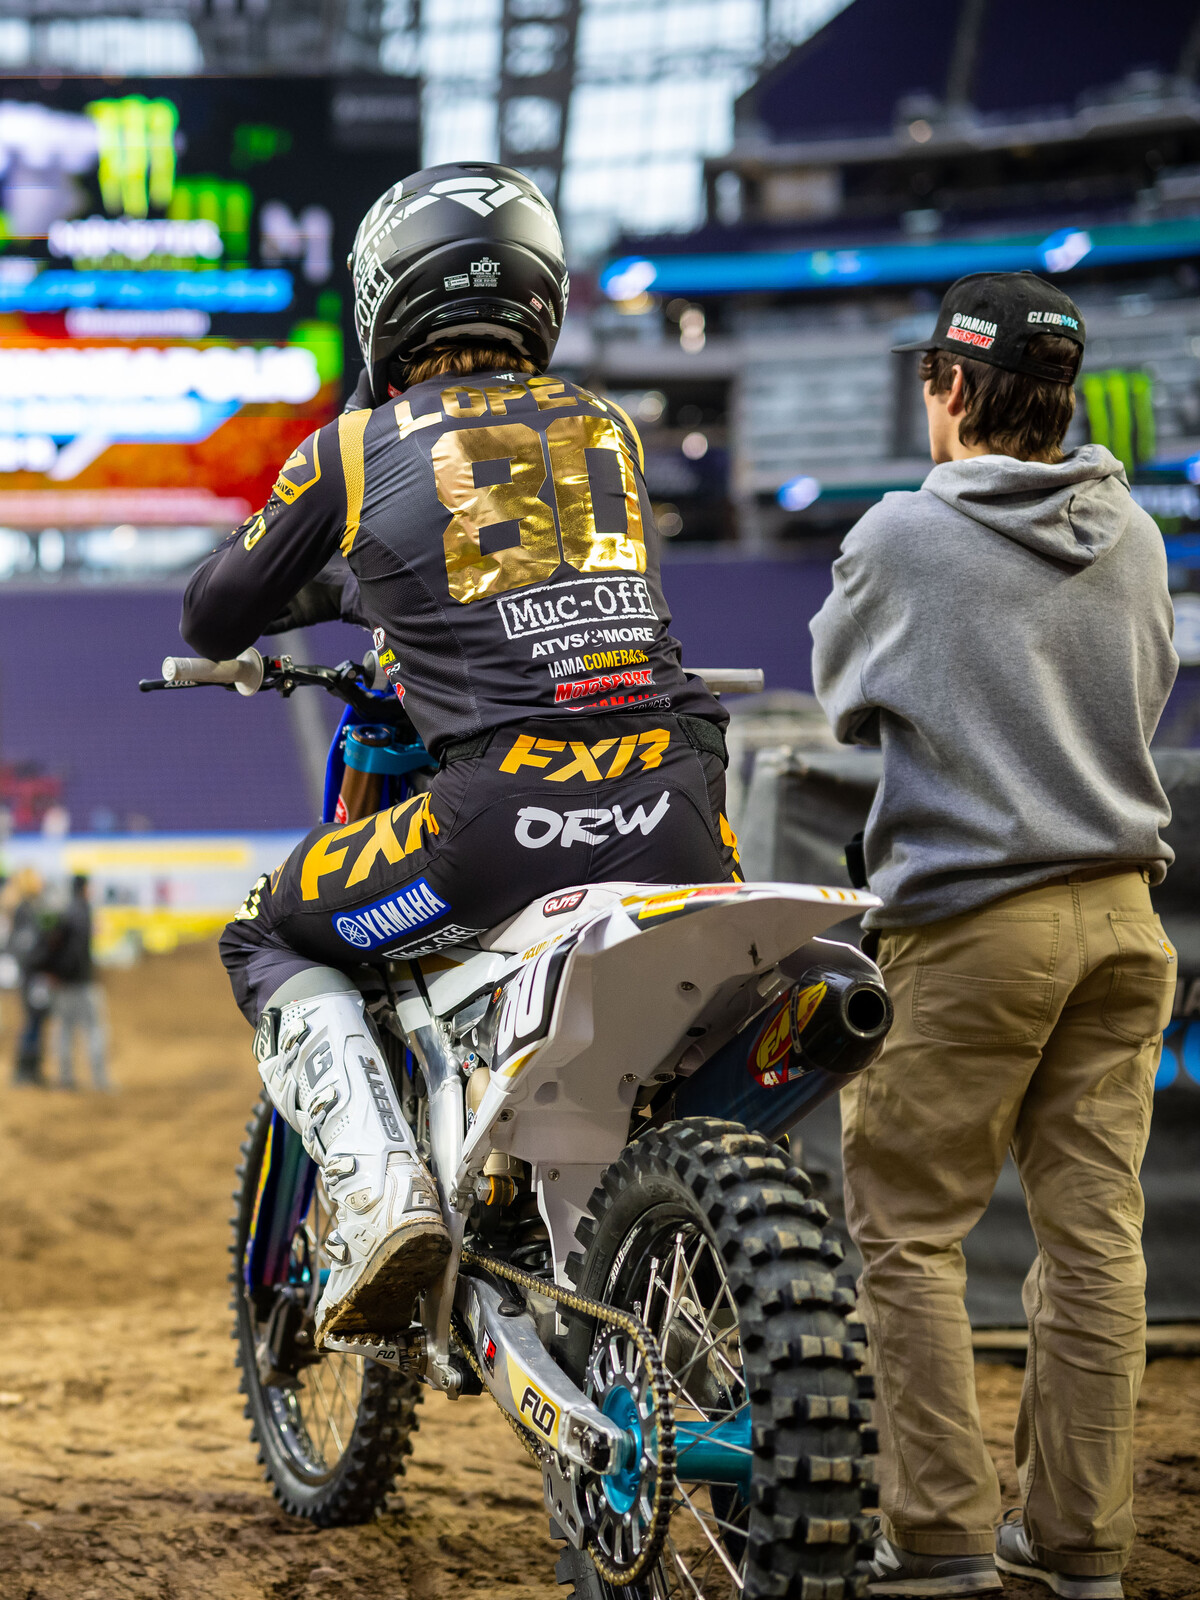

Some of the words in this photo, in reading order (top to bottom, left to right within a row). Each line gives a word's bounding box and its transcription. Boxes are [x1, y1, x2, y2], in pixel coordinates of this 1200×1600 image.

[470, 262, 500, 273] DOT
[960, 315, 997, 337] YAMAHA
[1027, 311, 1078, 330] CLUBMX
[431, 415, 648, 604] 80
[506, 582, 652, 632] Muc-Off
[531, 627, 656, 659] ATVS&MORE
[547, 649, 650, 679] IAMACOMEBACK
[498, 727, 671, 782] FXR
[514, 790, 671, 849] ORW
[355, 882, 446, 940] YAMAHA
[544, 891, 584, 914] GUTS
[375, 1350, 396, 1360] FLO
[519, 1386, 556, 1437] FLO
